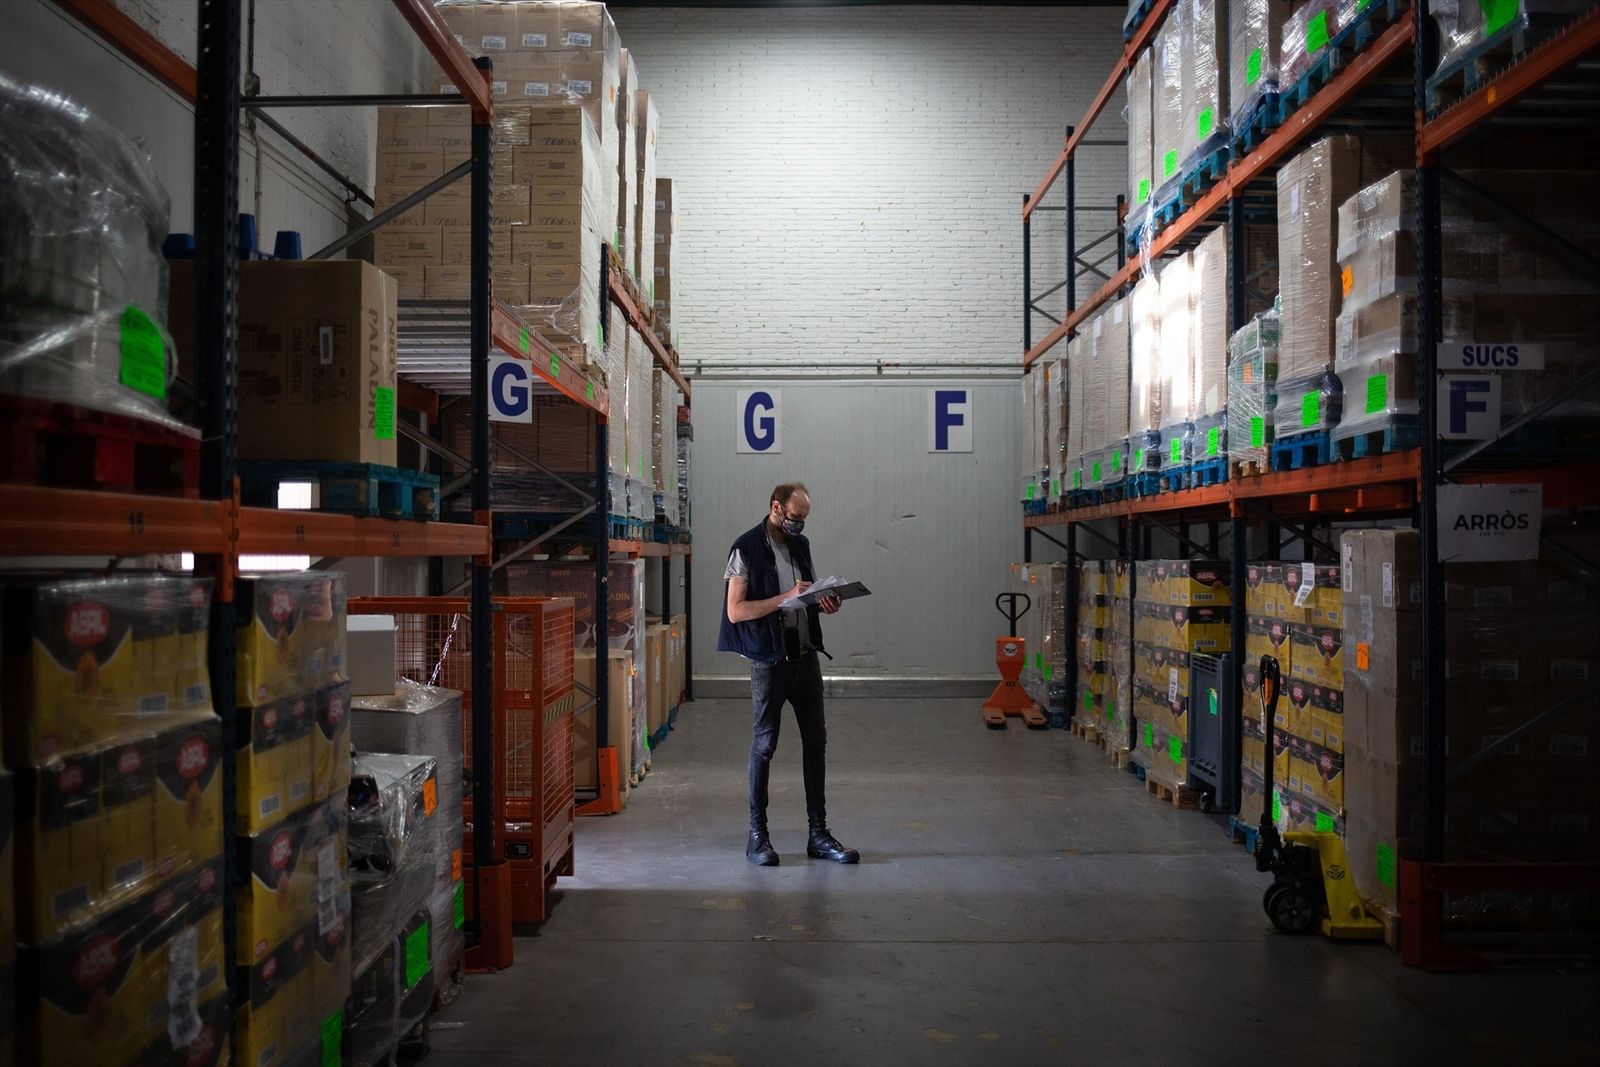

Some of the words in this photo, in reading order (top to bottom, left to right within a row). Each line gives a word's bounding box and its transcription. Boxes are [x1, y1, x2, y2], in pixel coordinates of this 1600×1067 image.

[1462, 345, 1519, 367] SUCS
[491, 362, 529, 417] G
[1450, 380, 1490, 433] F
[743, 391, 776, 451] G
[935, 390, 967, 451] F
[1453, 510, 1529, 530] ARRÒS
